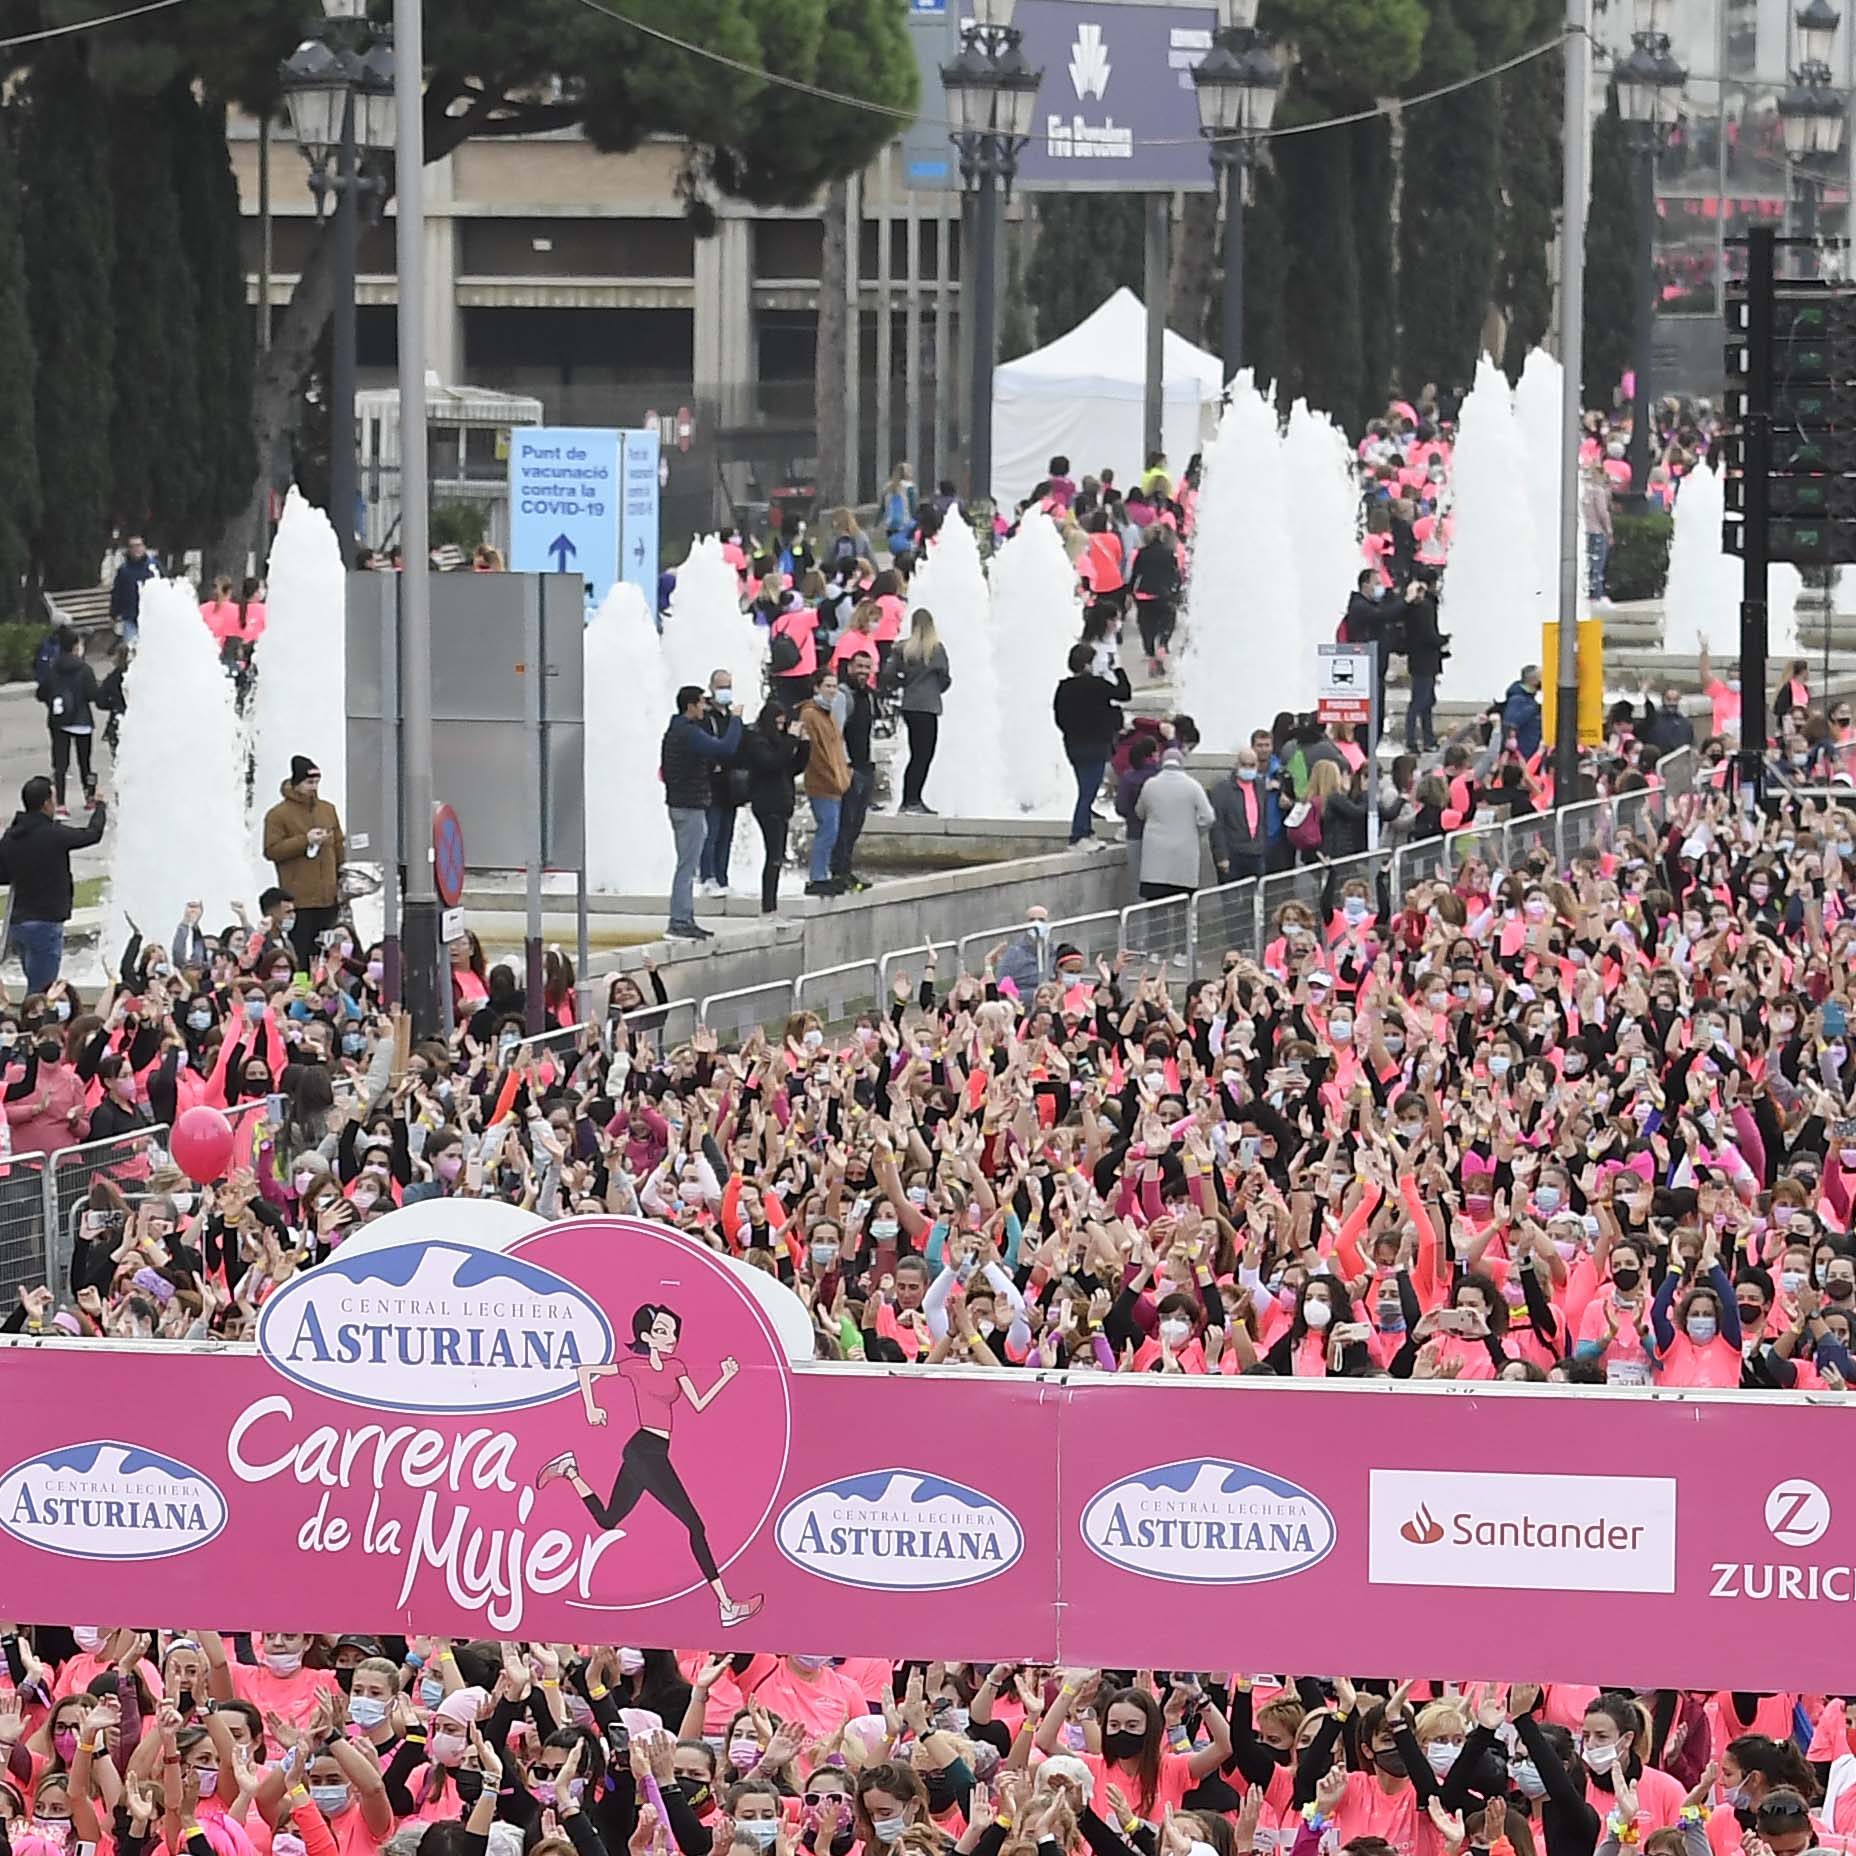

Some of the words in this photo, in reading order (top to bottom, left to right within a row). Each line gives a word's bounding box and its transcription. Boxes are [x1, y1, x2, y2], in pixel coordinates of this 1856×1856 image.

[522, 445, 561, 459] Punt
[566, 446, 587, 460] de
[522, 465, 608, 480] vacunació
[521, 483, 576, 498] contra
[581, 484, 596, 498] la
[521, 500, 605, 517] COVID-19
[340, 1296, 451, 1316] CENTRAL
[462, 1300, 573, 1320] LECHERA
[285, 1300, 583, 1371] ASTURIANA
[227, 1395, 517, 1491] Carrera
[44, 1479, 120, 1495] CENTRAL
[125, 1483, 201, 1498] LECHERA
[9, 1482, 209, 1532] ASTURIANA
[831, 1508, 911, 1524] CENTRAL
[917, 1511, 997, 1527] LECHERA
[1139, 1499, 1219, 1515] CENTRAL
[1225, 1502, 1308, 1518] LECHERA
[795, 1510, 1003, 1561] ASTURIANA
[1100, 1501, 1315, 1553] ASTURIANA
[1451, 1513, 1645, 1551] Santander
[298, 1491, 351, 1553] de
[363, 1491, 401, 1556] la
[397, 1485, 627, 1633] Mujer
